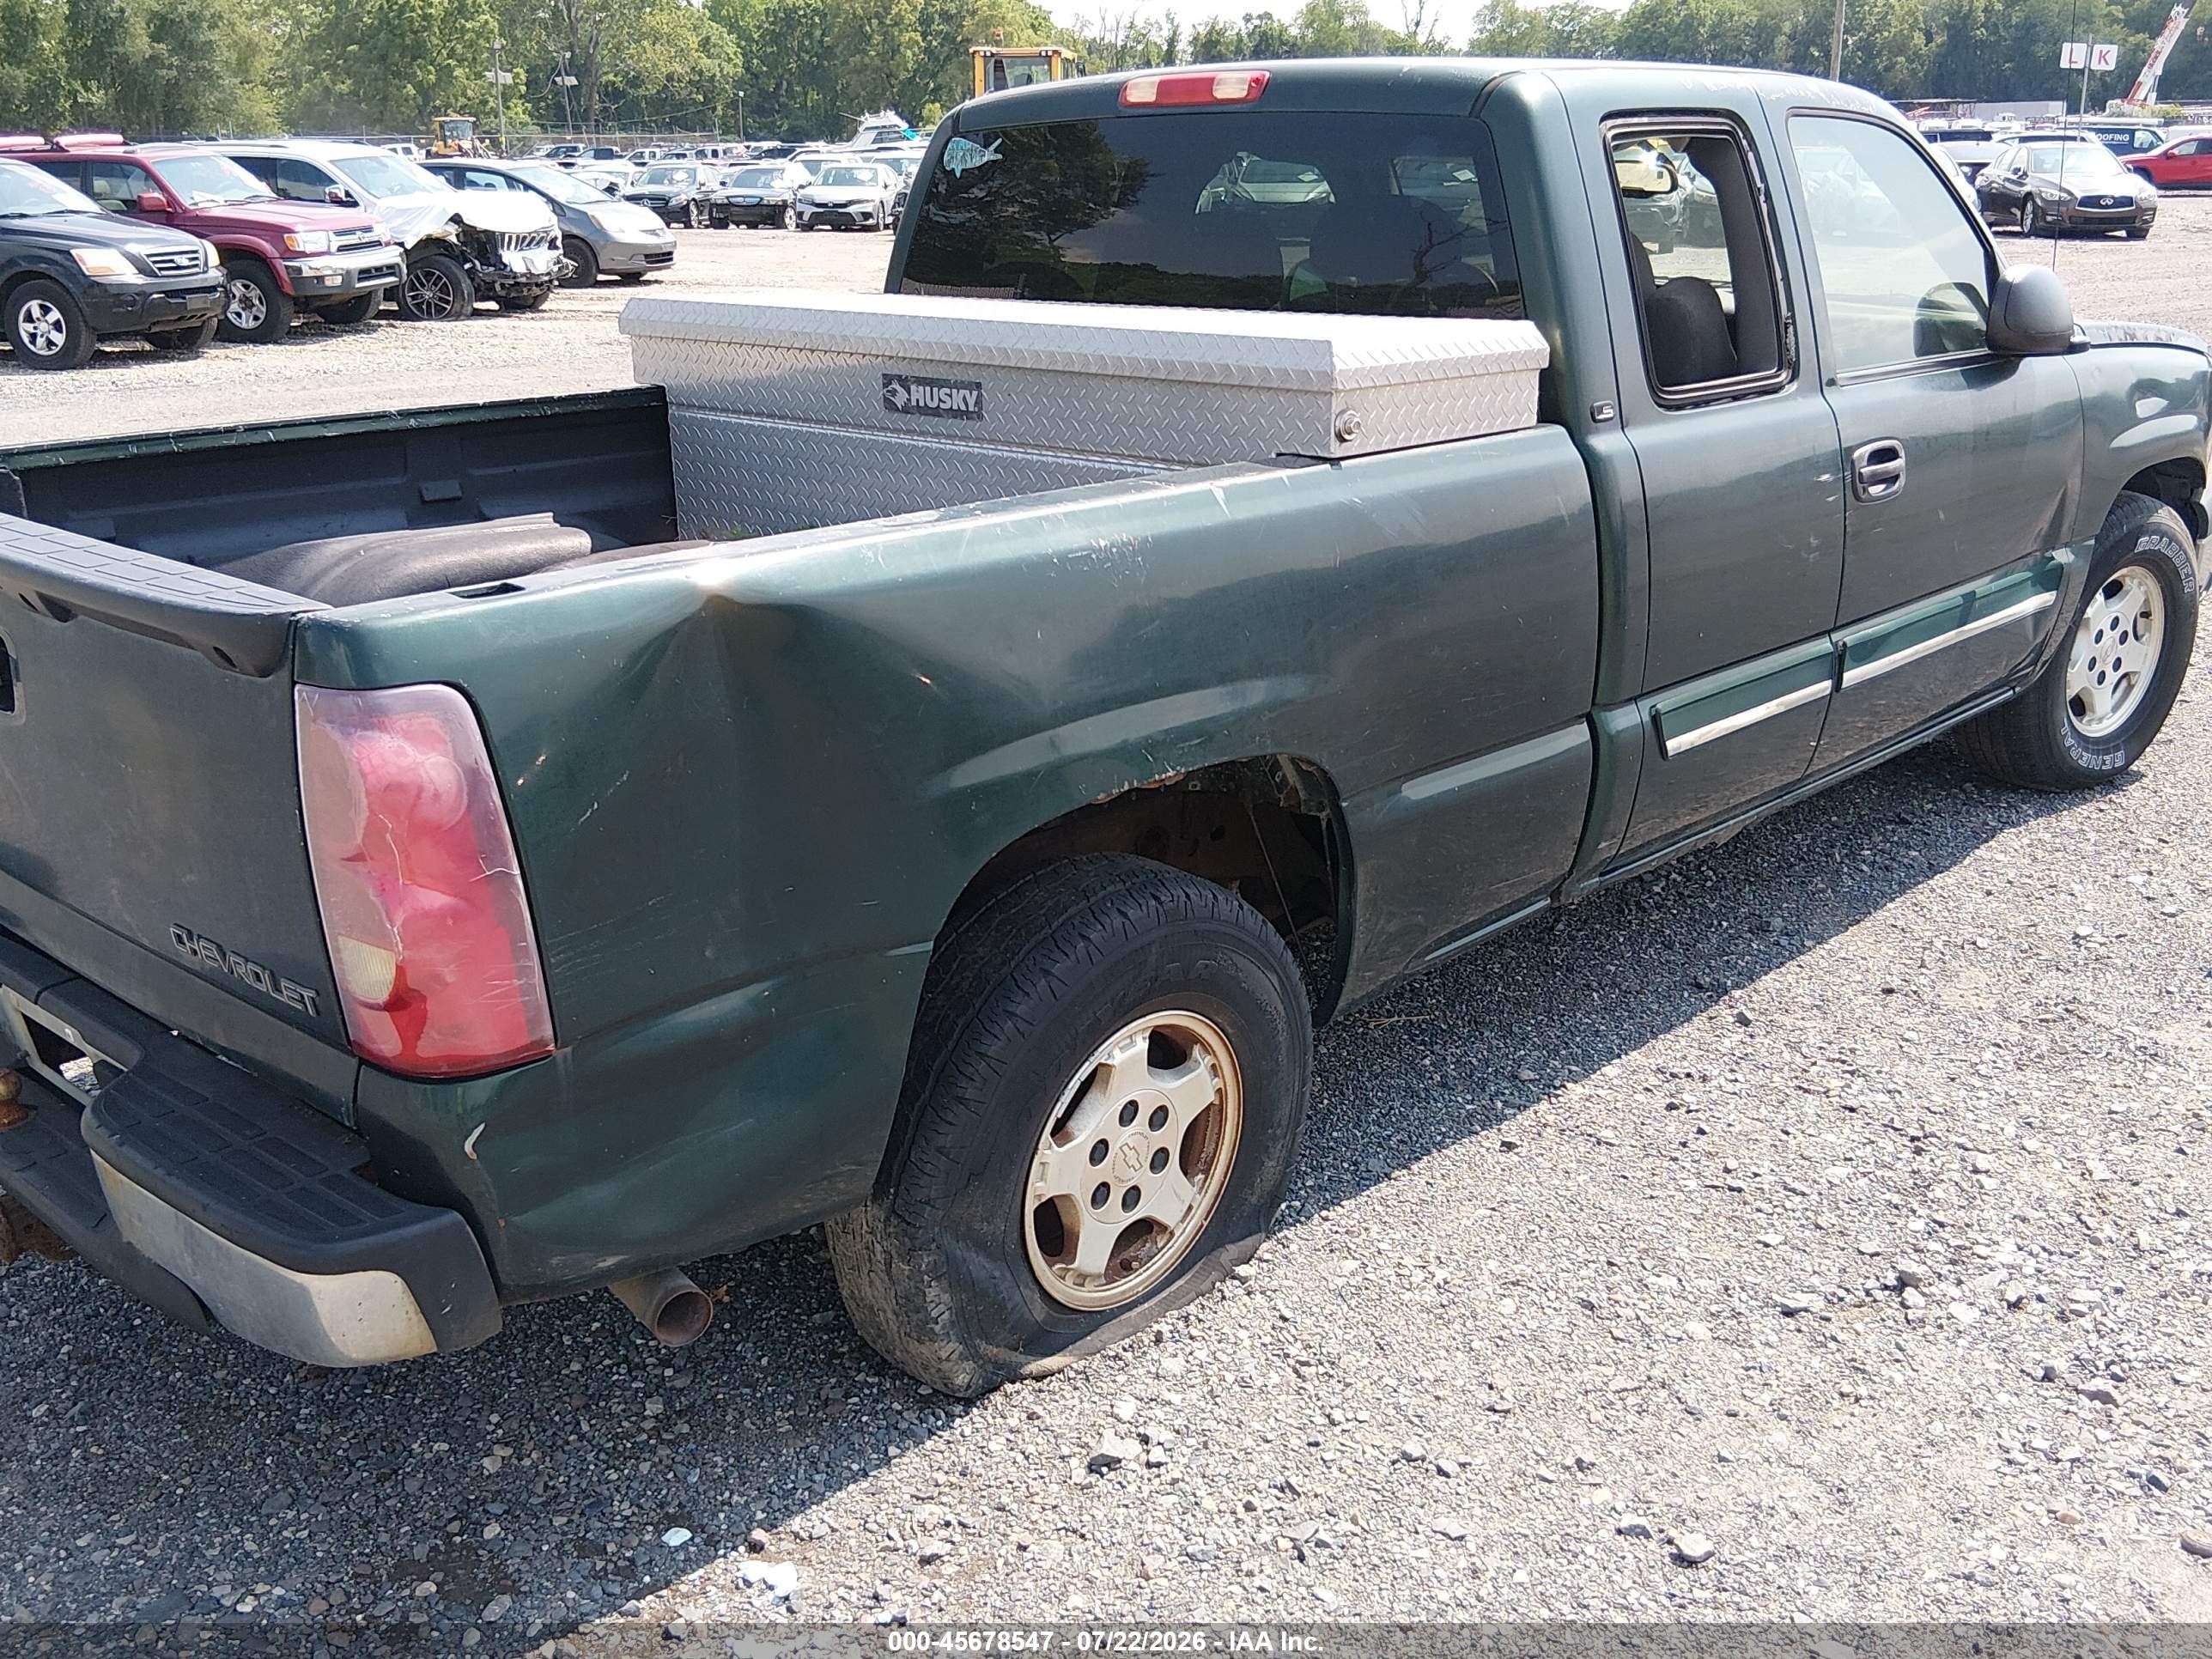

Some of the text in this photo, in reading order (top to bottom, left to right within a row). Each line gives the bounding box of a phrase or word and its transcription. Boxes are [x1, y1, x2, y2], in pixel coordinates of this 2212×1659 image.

[2069, 47, 2078, 64] L
[2098, 49, 2112, 65] K
[2096, 133, 2130, 142] OOFING
[910, 385, 978, 411] HUSKY
[2134, 535, 2195, 593] GRABBER
[2060, 718, 2125, 770] GENERAL
[170, 924, 318, 1017] CHEVROLET
